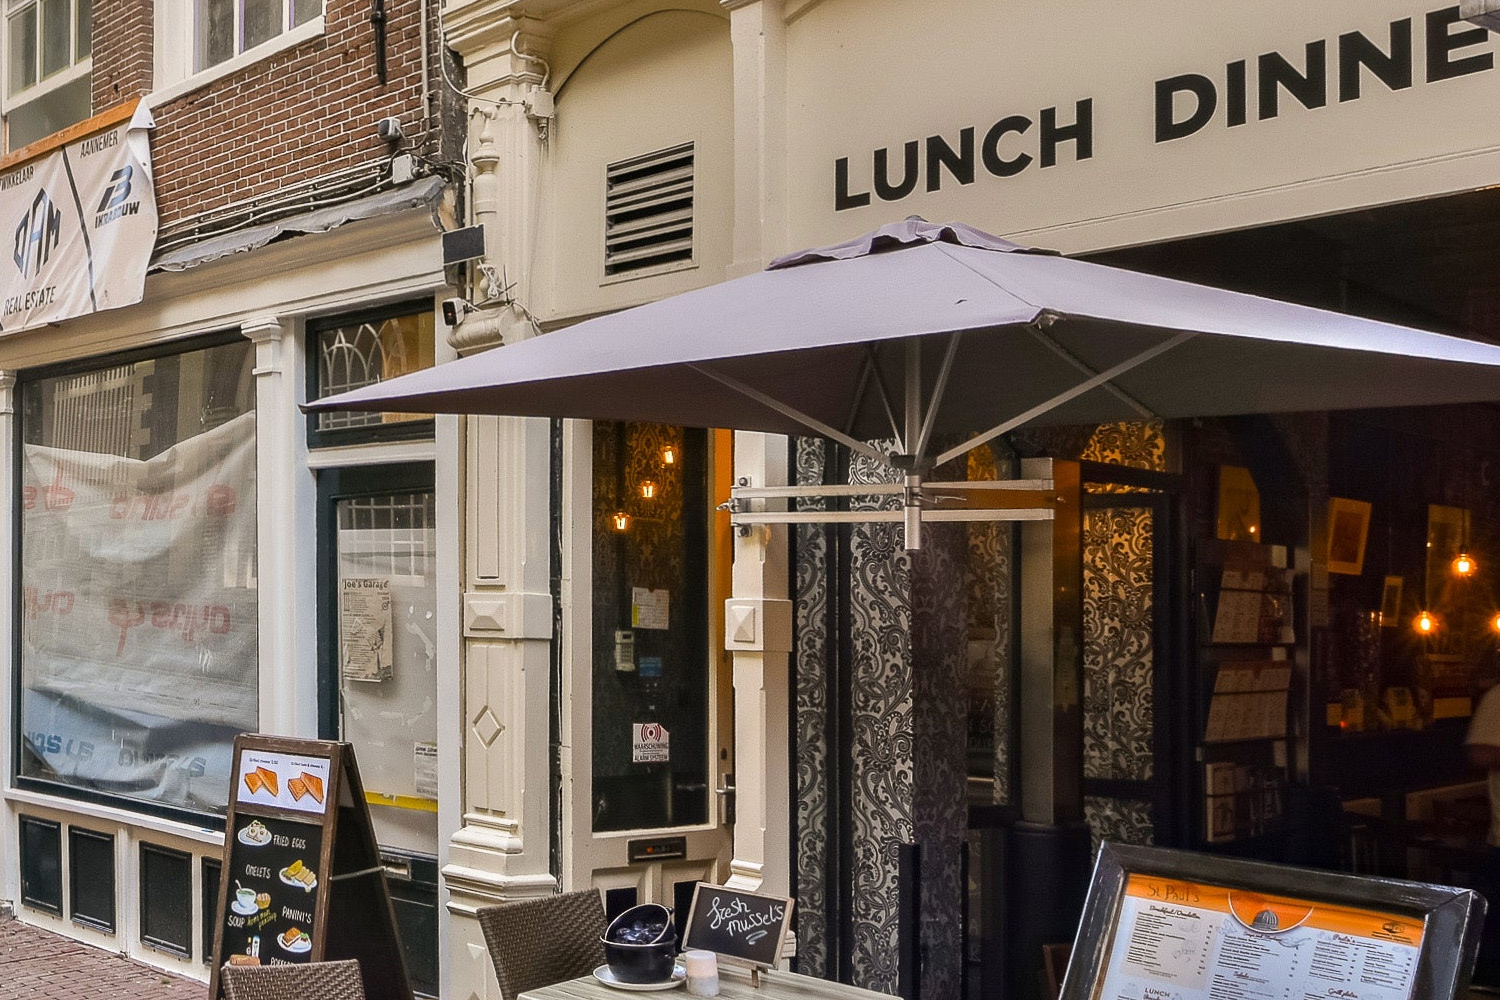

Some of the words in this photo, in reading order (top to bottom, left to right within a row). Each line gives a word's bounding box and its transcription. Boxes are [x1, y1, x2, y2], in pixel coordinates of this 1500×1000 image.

[834, 98, 1094, 212] LUNCH
[1154, 5, 1495, 145] DINNE
[80, 130, 118, 159] AANNEMER
[3, 296, 23, 316] REAL
[24, 286, 57, 310] ESTATE
[273, 834, 289, 847] FRIED
[291, 838, 306, 850] EGGS
[245, 864, 271, 879] OMELETS
[228, 915, 245, 929] SOUP
[282, 906, 312, 924] PANINI'S
[1145, 987, 1170, 998] LUNCH
